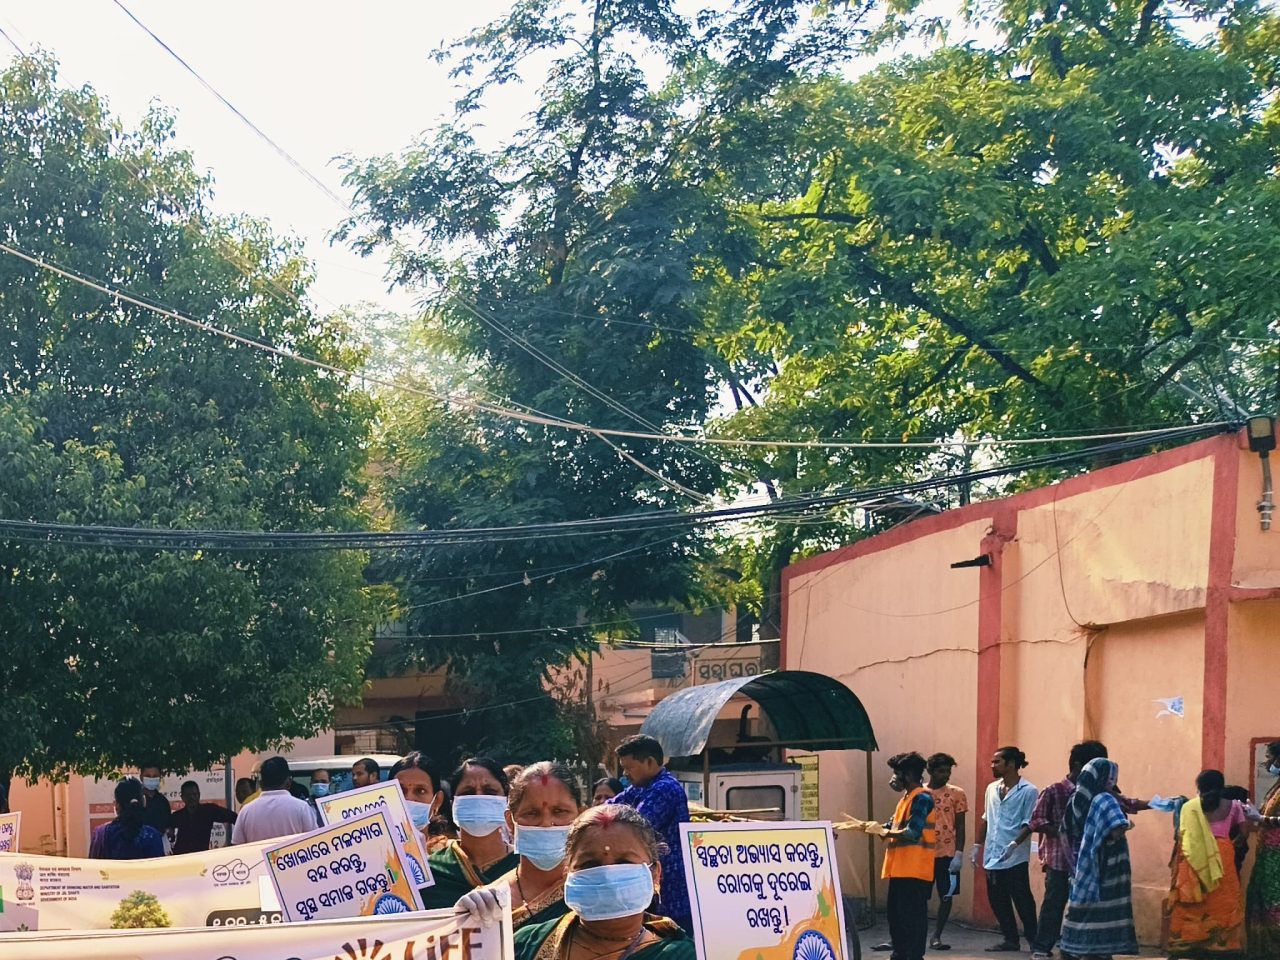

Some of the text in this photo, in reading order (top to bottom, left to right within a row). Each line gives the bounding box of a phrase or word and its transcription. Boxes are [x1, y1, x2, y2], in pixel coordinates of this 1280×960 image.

[276, 841, 331, 871] ଖୋଲାରେ
[696, 845, 733, 868] ସ୍ୱଚ୍ଛତା
[307, 865, 328, 883] ବନ୍ଦ
[717, 871, 812, 901] ରୋଗକୁ ଦୂରେଇ
[320, 885, 354, 909] ସମାଜ
